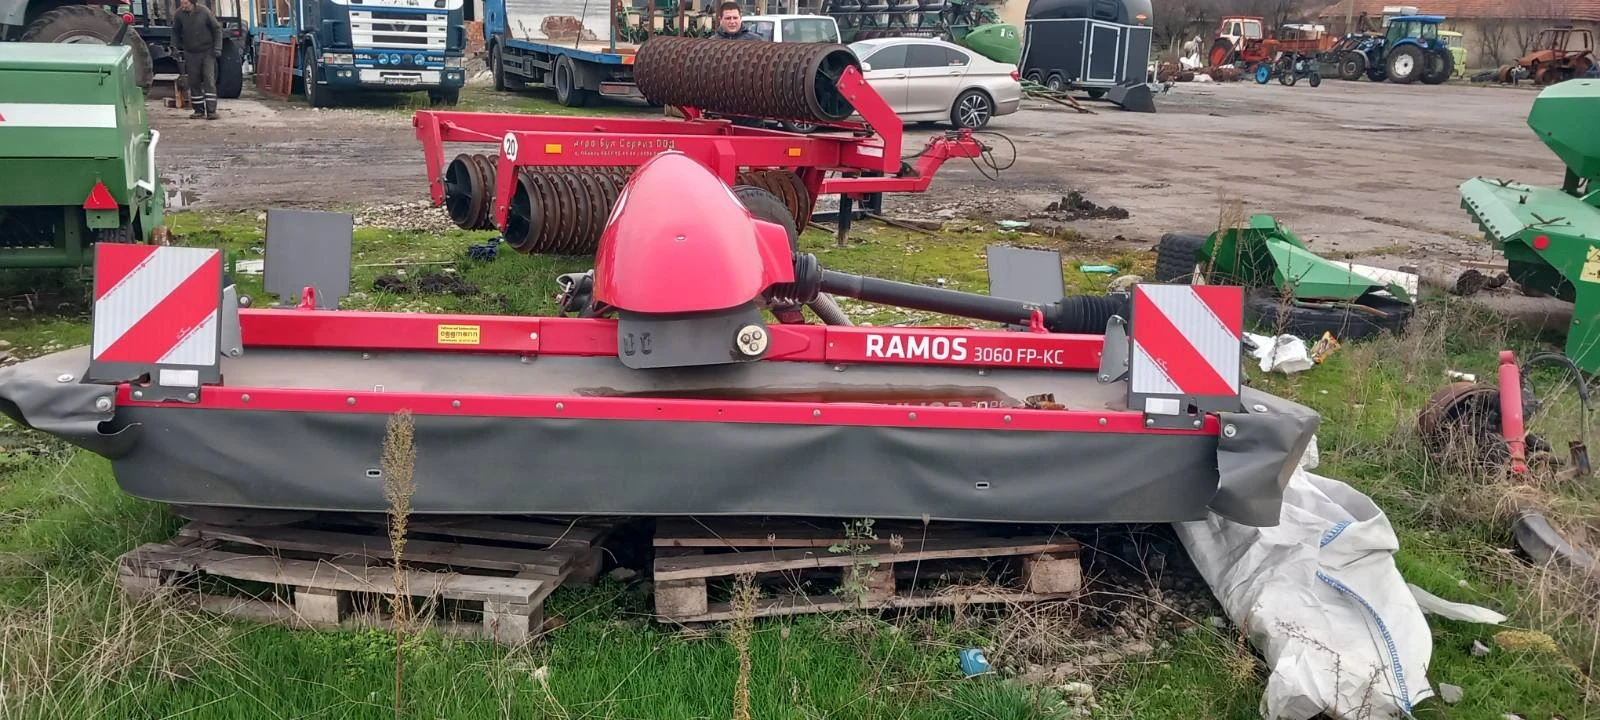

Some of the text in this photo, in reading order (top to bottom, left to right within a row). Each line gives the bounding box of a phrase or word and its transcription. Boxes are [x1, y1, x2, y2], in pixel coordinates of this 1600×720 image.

[506, 137, 516, 157] 20
[865, 334, 1065, 365] RAMOS 3060 FP-KC
